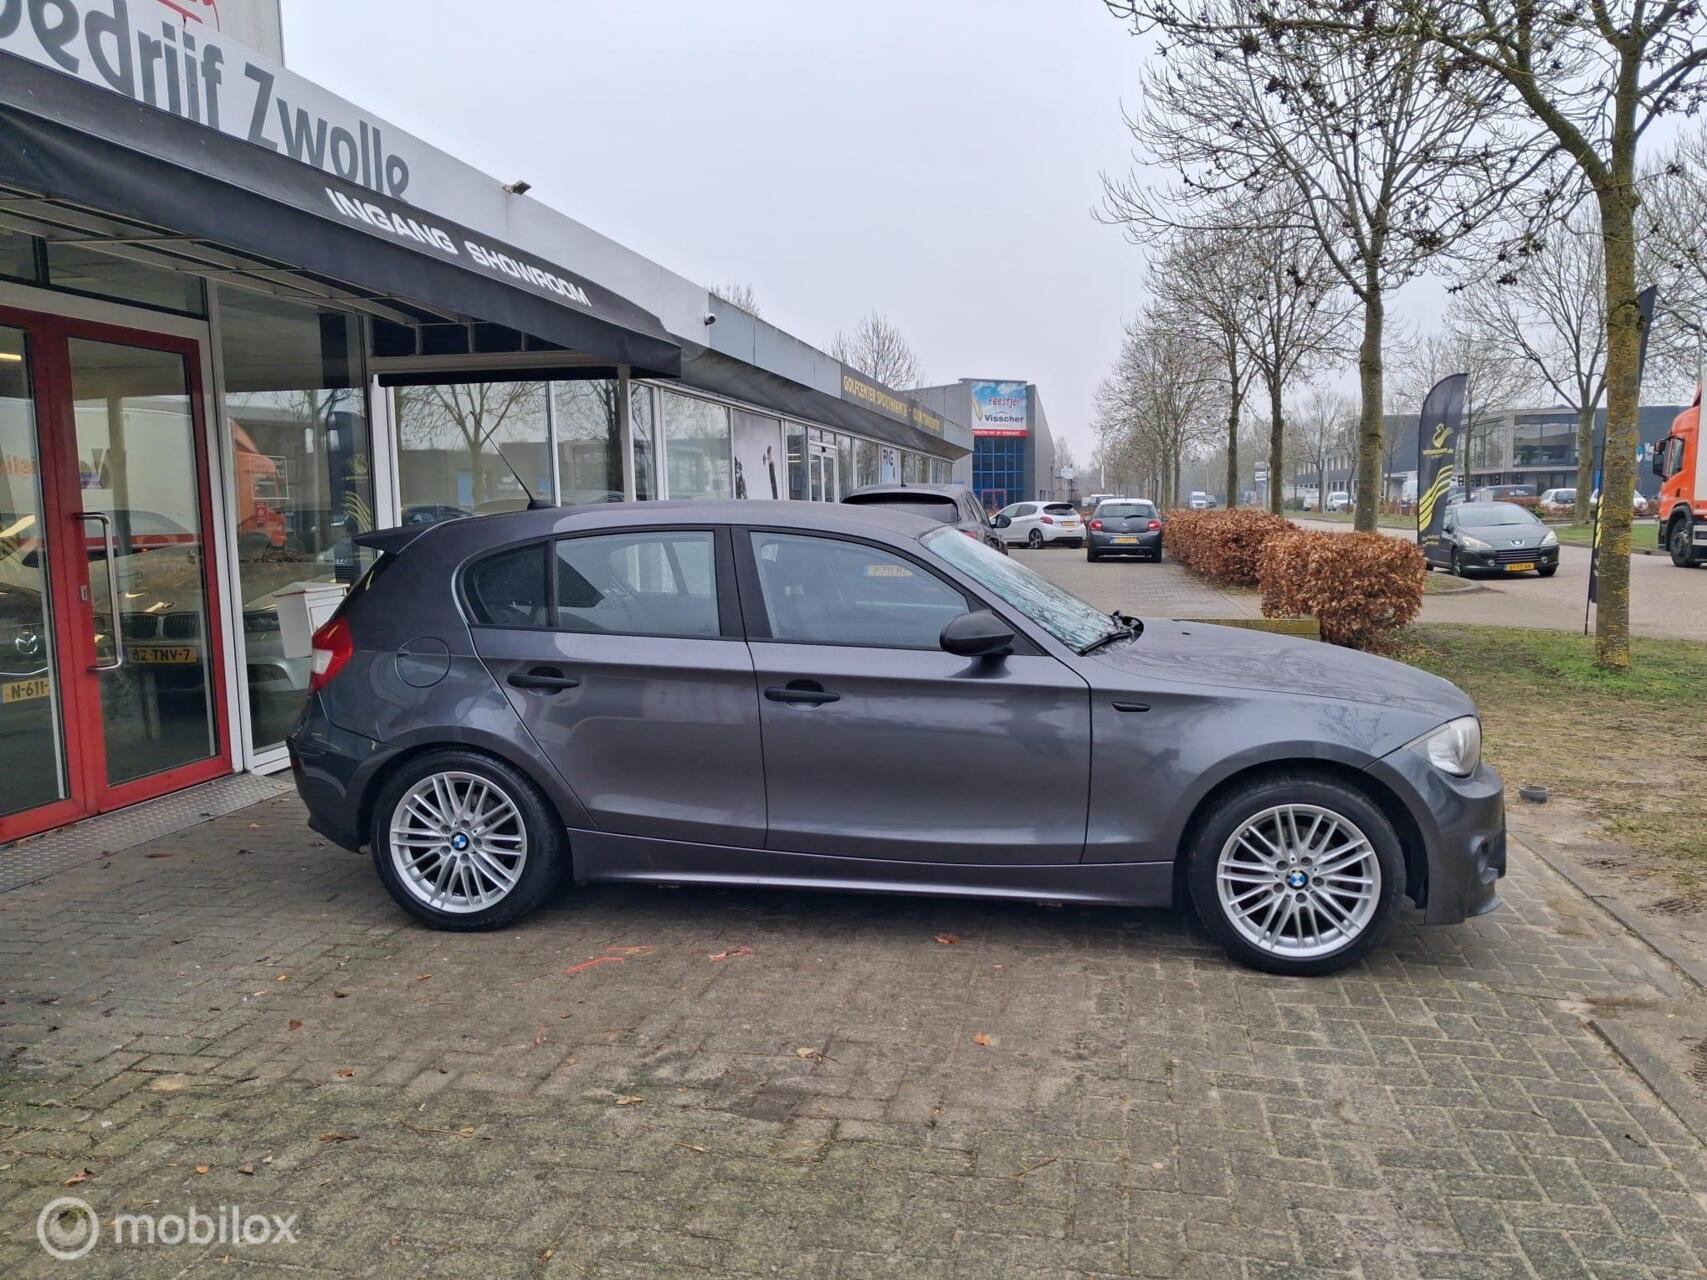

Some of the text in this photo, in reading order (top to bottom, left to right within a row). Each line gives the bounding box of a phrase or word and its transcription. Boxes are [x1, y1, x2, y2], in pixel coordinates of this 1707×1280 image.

[244, 62, 409, 204] Zwolle
[325, 187, 592, 307] INGANG SHOWROOM
[984, 414, 1025, 423] Visscher
[11, 681, 49, 699] N-611-
